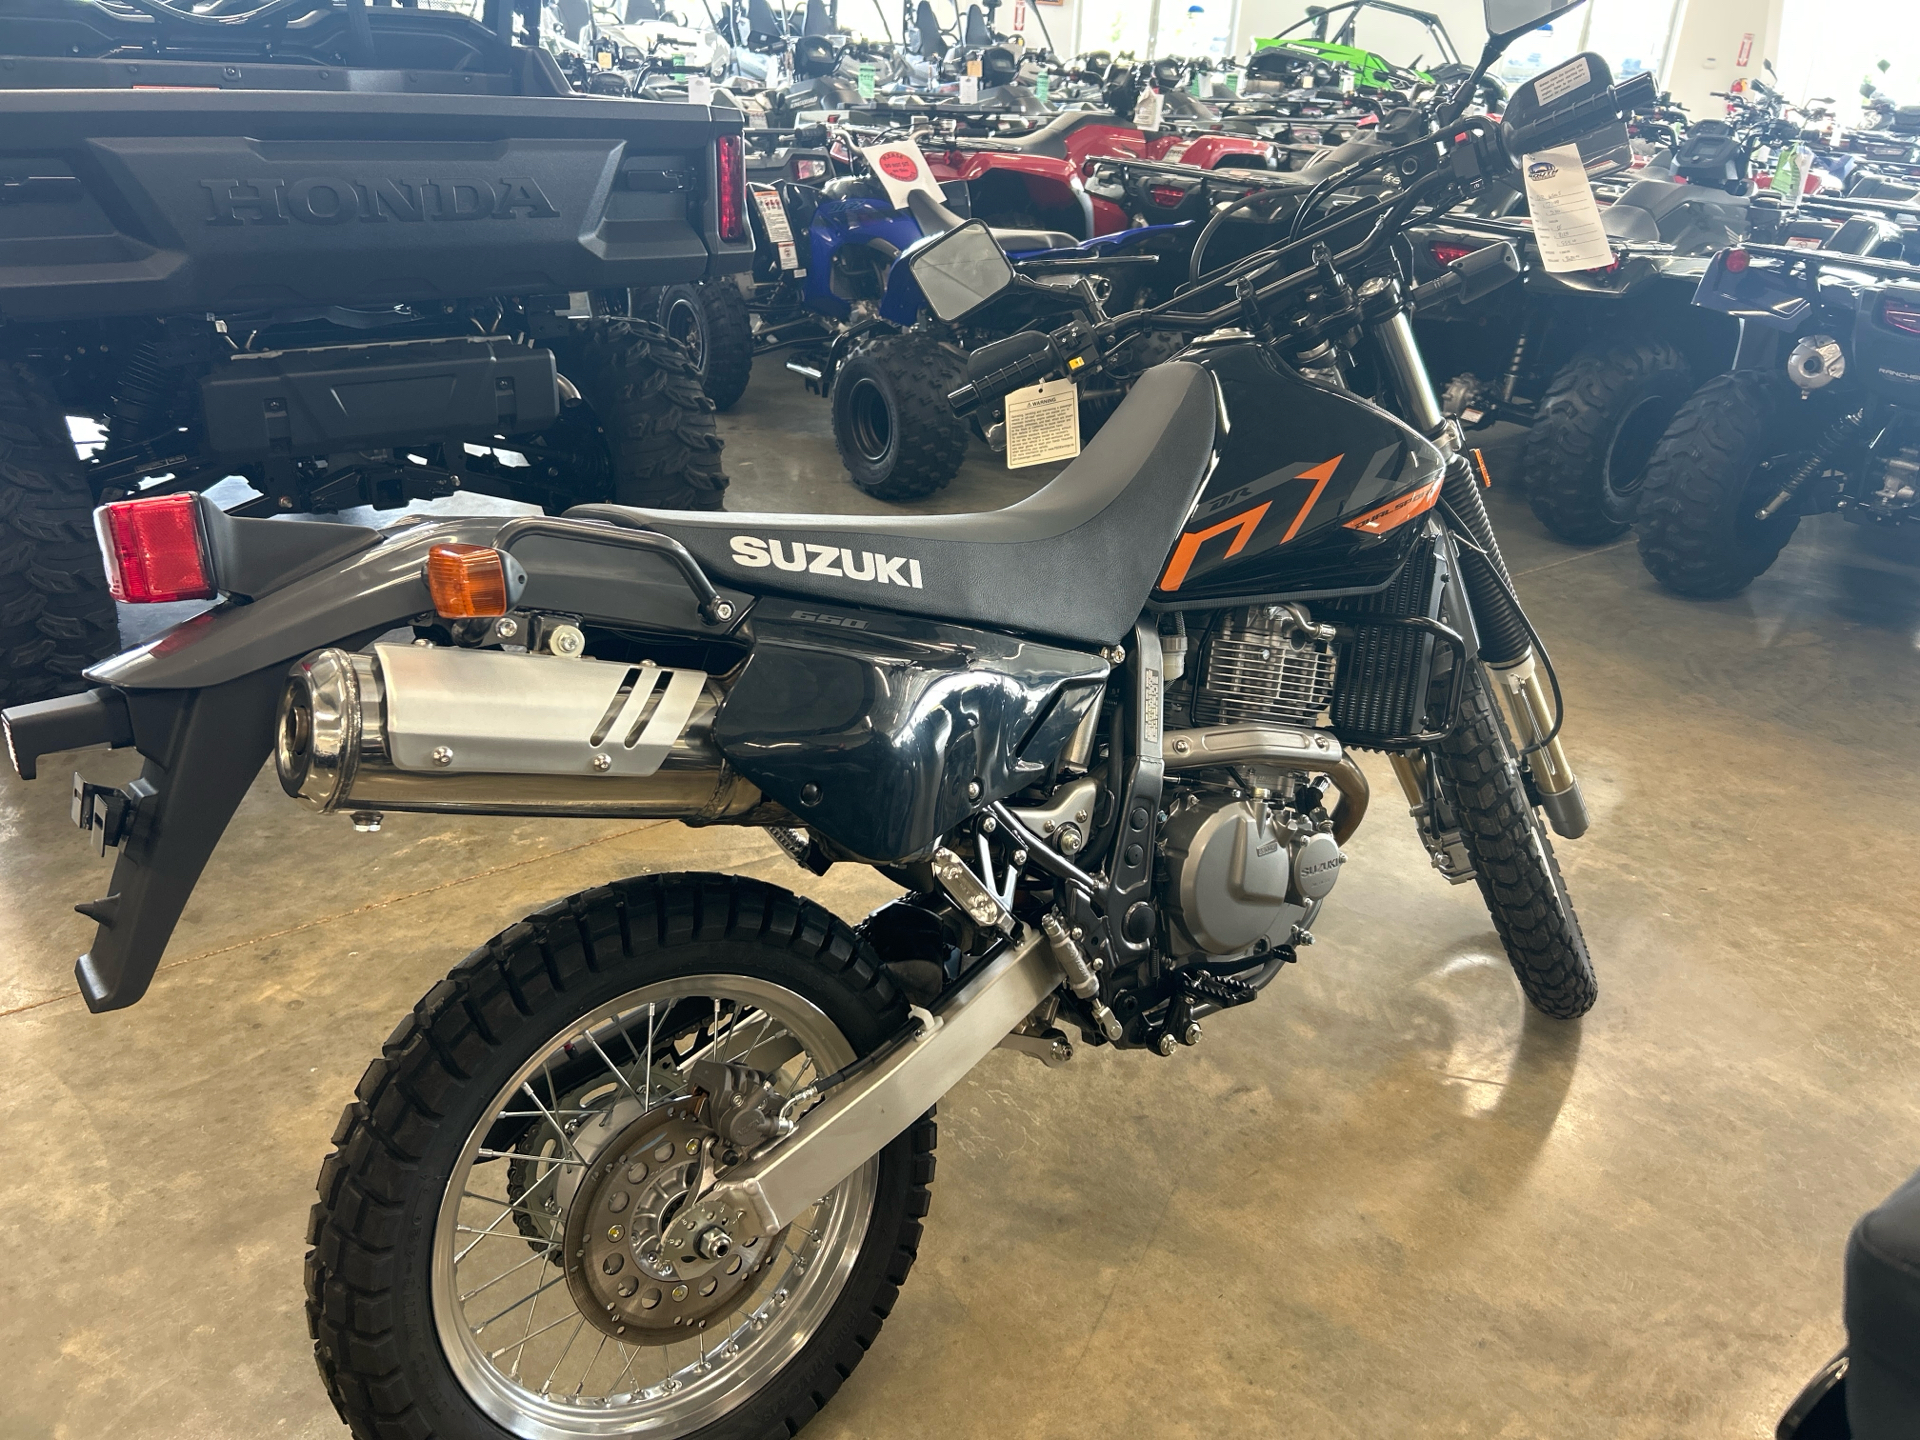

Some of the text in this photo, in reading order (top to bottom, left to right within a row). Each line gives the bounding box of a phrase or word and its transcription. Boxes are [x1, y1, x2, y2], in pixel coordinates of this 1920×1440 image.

[200, 177, 561, 226] HONDA
[1879, 367, 1920, 381] RANCHE
[1032, 397, 1057, 407] WARNING
[1209, 487, 1253, 513] DR
[1355, 508, 1391, 530] DUAL
[729, 535, 924, 590] SUZUKI
[791, 609, 868, 630] 650
[1301, 857, 1341, 877] SUZUKI
